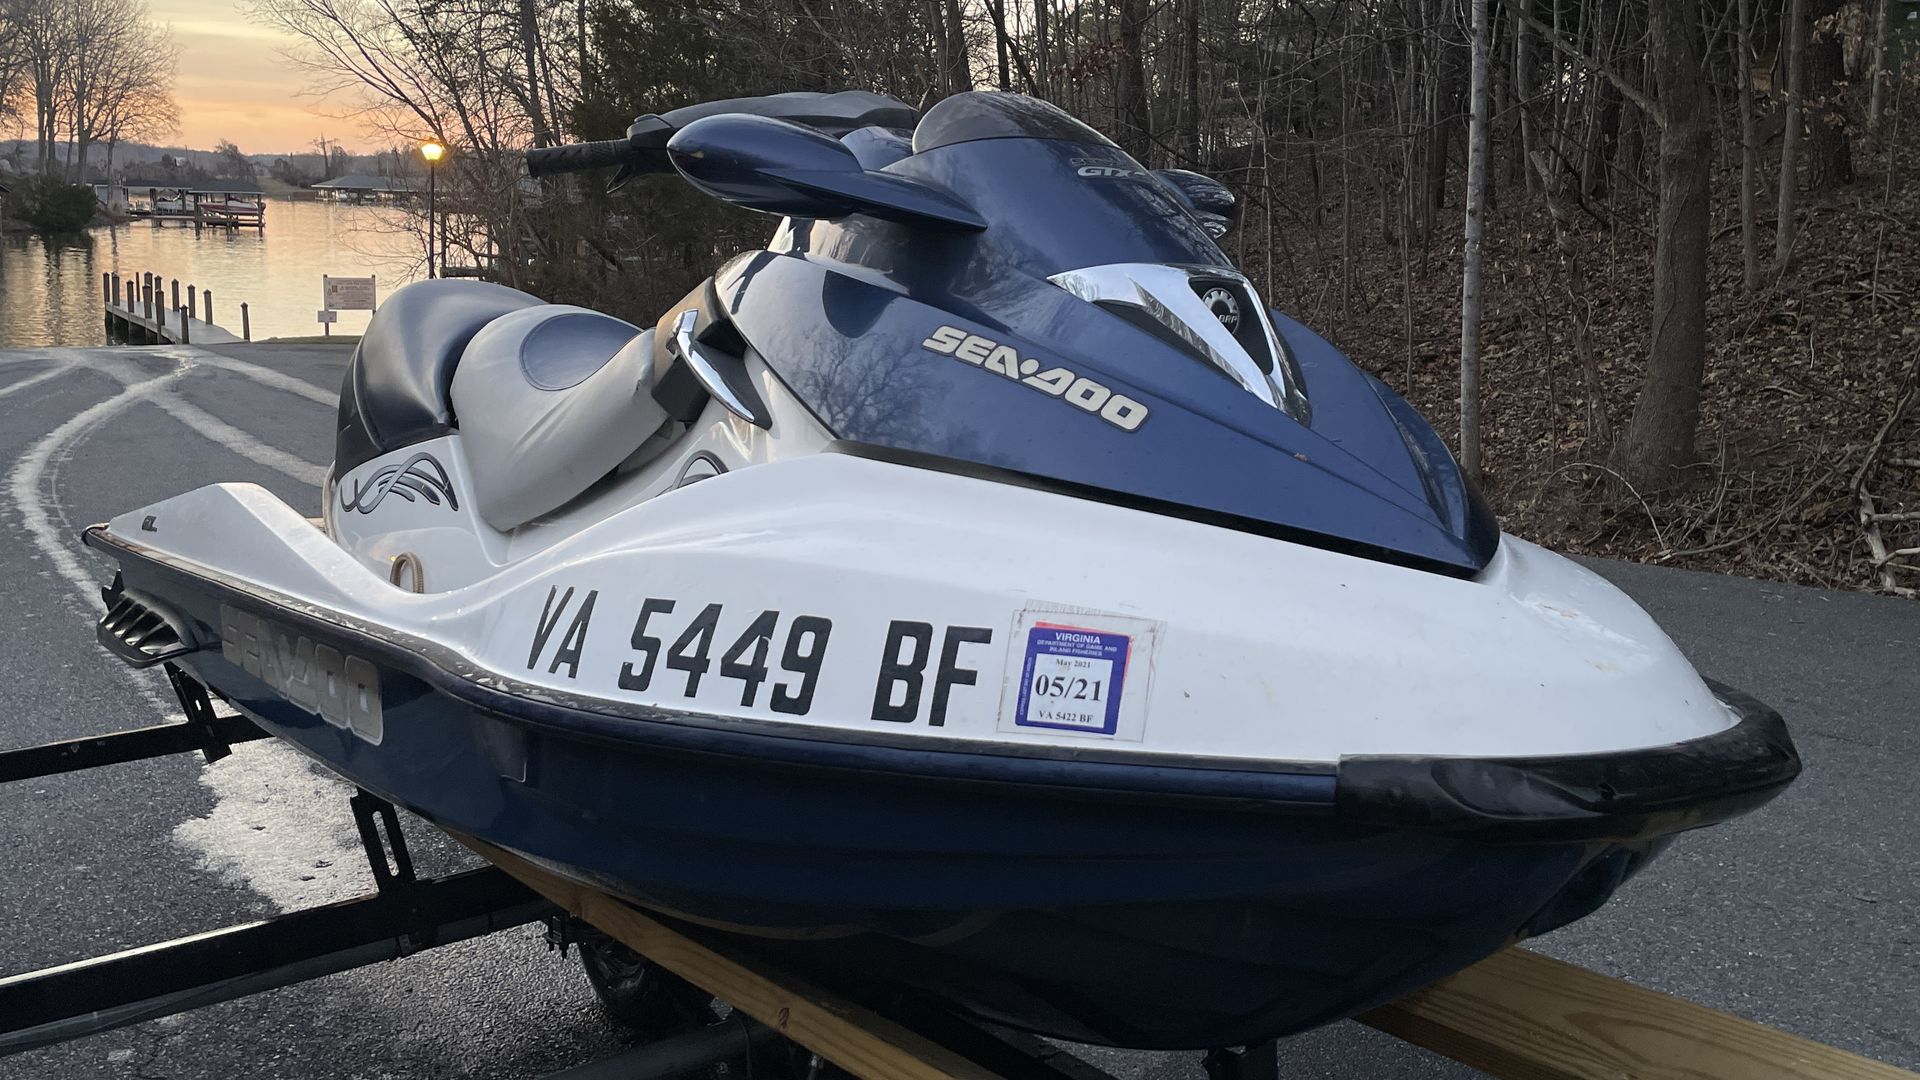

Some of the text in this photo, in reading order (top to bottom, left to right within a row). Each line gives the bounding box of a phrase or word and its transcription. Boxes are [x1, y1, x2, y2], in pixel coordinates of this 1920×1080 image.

[1218, 314, 1238, 323] BRP
[1055, 632, 1101, 645] VIRGINIA
[1104, 645, 1118, 653] AND
[526, 585, 599, 679] VA
[617, 597, 833, 716] 5449
[871, 619, 993, 727] BF
[1056, 658, 1091, 668] May 2021
[1035, 673, 1102, 702] 05/21
[1039, 709, 1094, 723] VA 5422 BF
